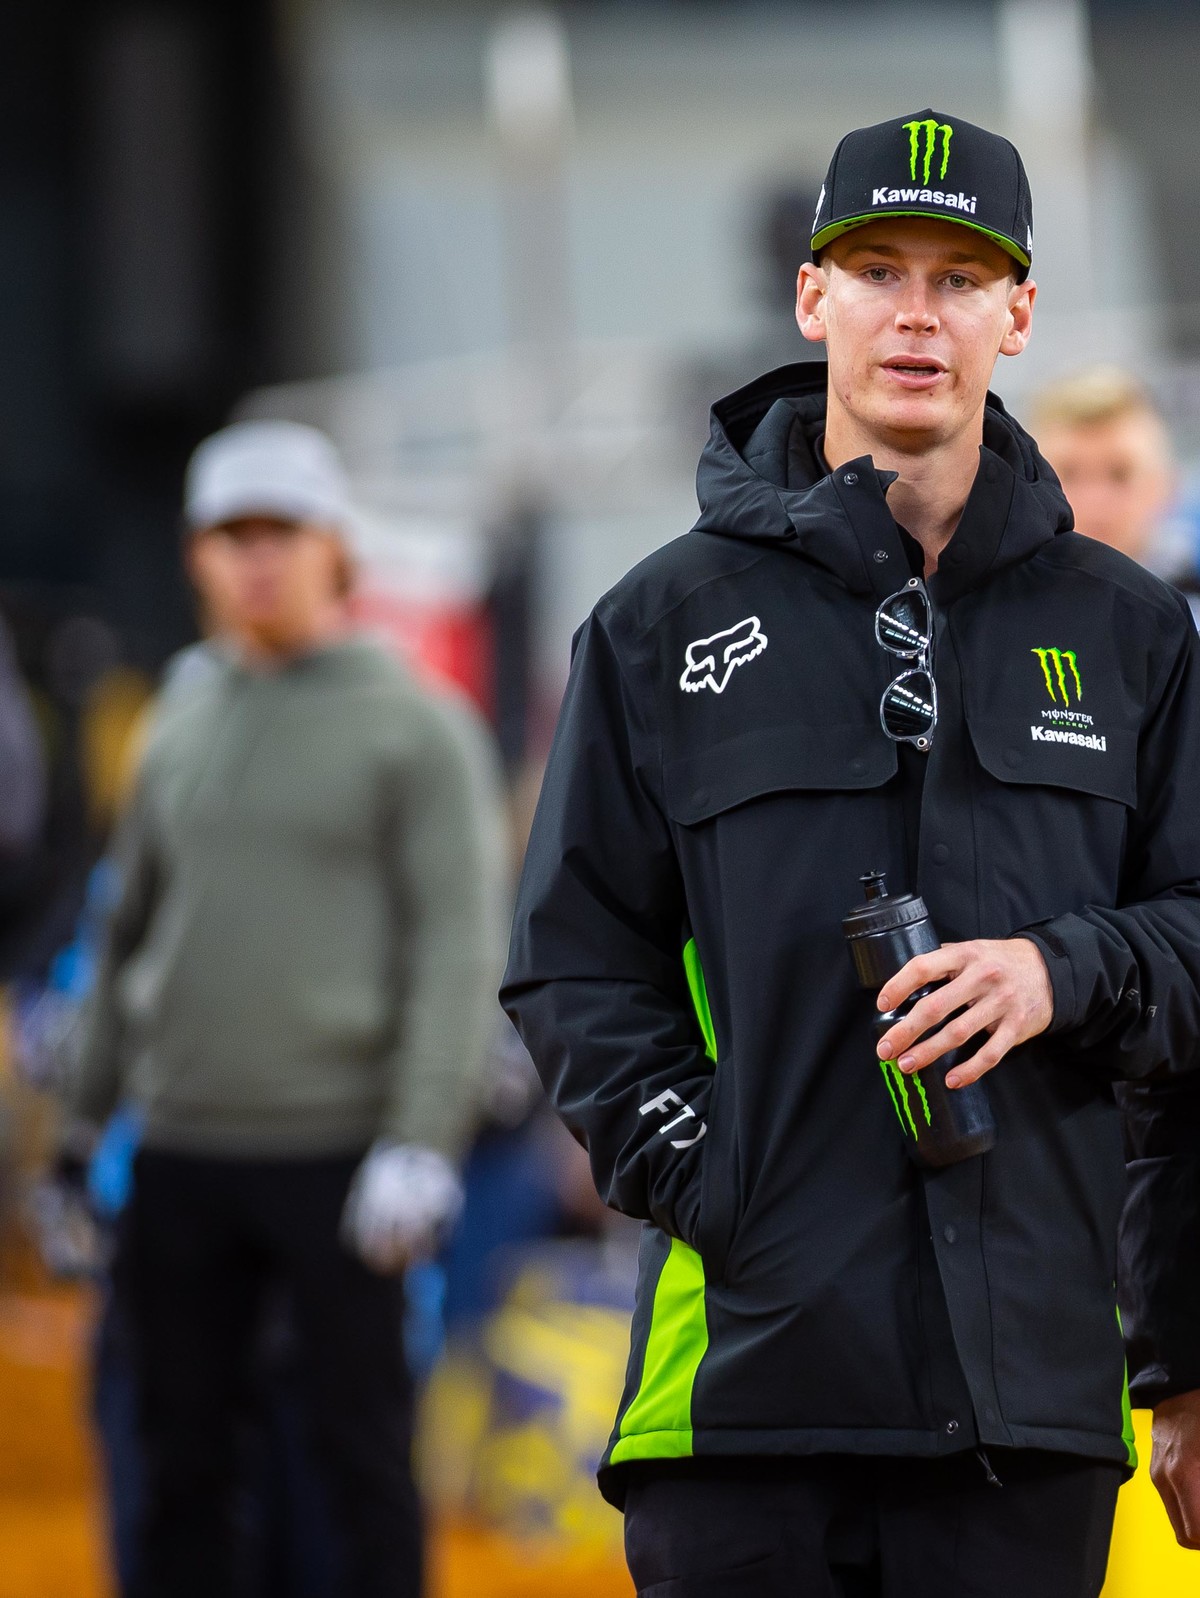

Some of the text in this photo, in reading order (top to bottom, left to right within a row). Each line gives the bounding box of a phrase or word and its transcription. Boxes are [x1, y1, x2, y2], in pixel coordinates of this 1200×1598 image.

[872, 187, 977, 214] Kawasaki
[1041, 709, 1094, 725] MONSTER
[1052, 720, 1088, 729] ENERGY
[1030, 726, 1107, 751] Kawasaki
